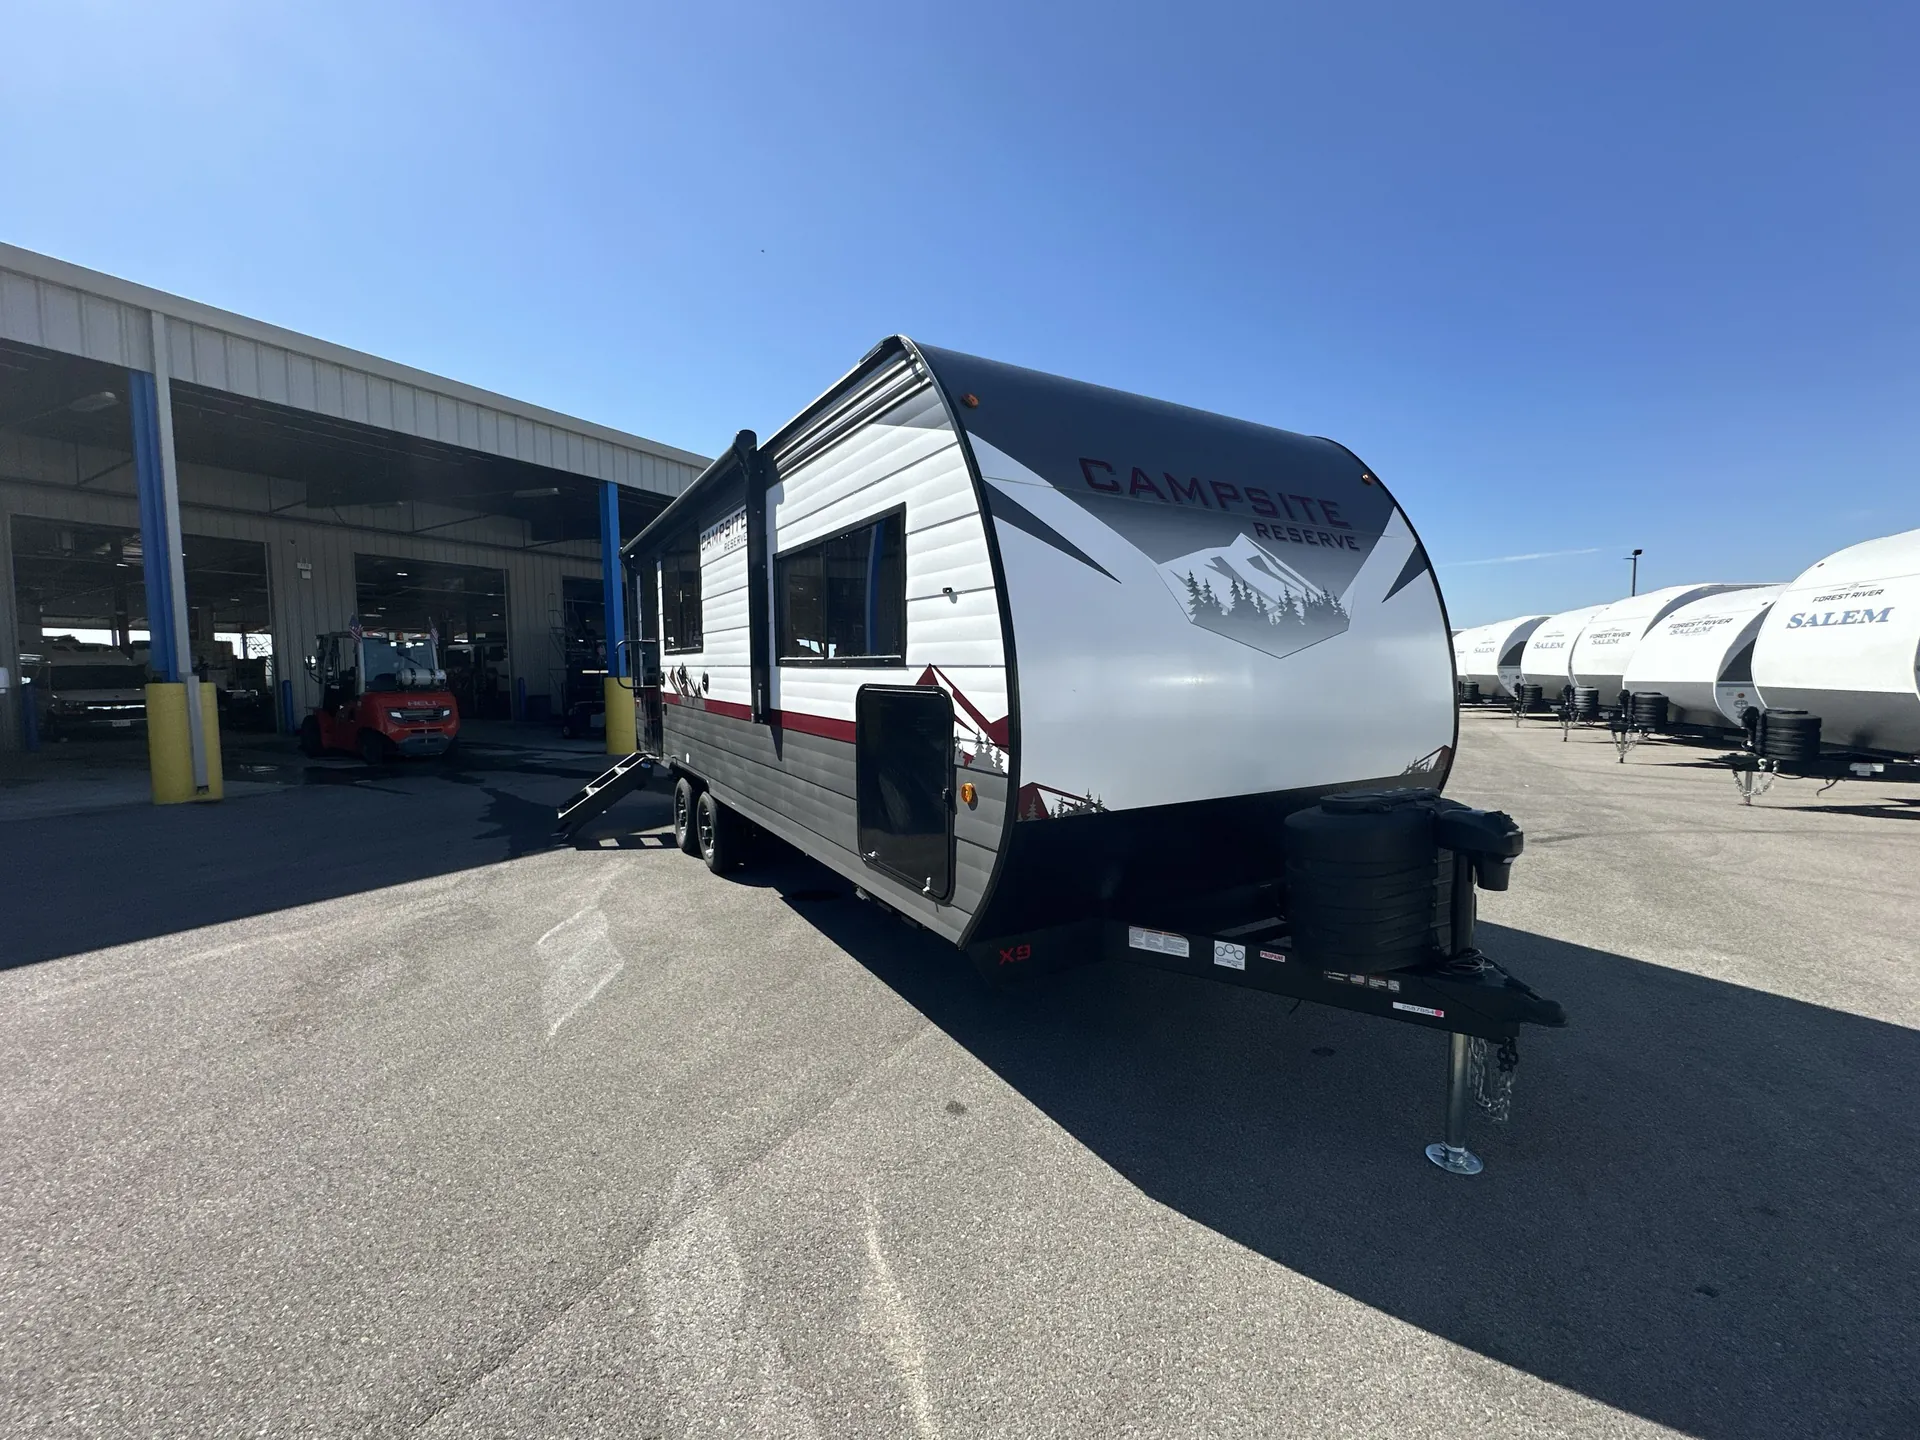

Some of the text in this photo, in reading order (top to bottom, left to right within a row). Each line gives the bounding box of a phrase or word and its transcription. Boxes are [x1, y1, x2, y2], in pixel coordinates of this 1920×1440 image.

[1078, 457, 1352, 531] CAMPSITE
[702, 510, 747, 551] CAMPSITE
[1253, 522, 1361, 552] RESERVE
[1812, 589, 1884, 603] FOREST RIVER
[1785, 606, 1895, 629] SALEM
[999, 944, 1031, 965] X9
[1261, 952, 1284, 962] PROPANE
